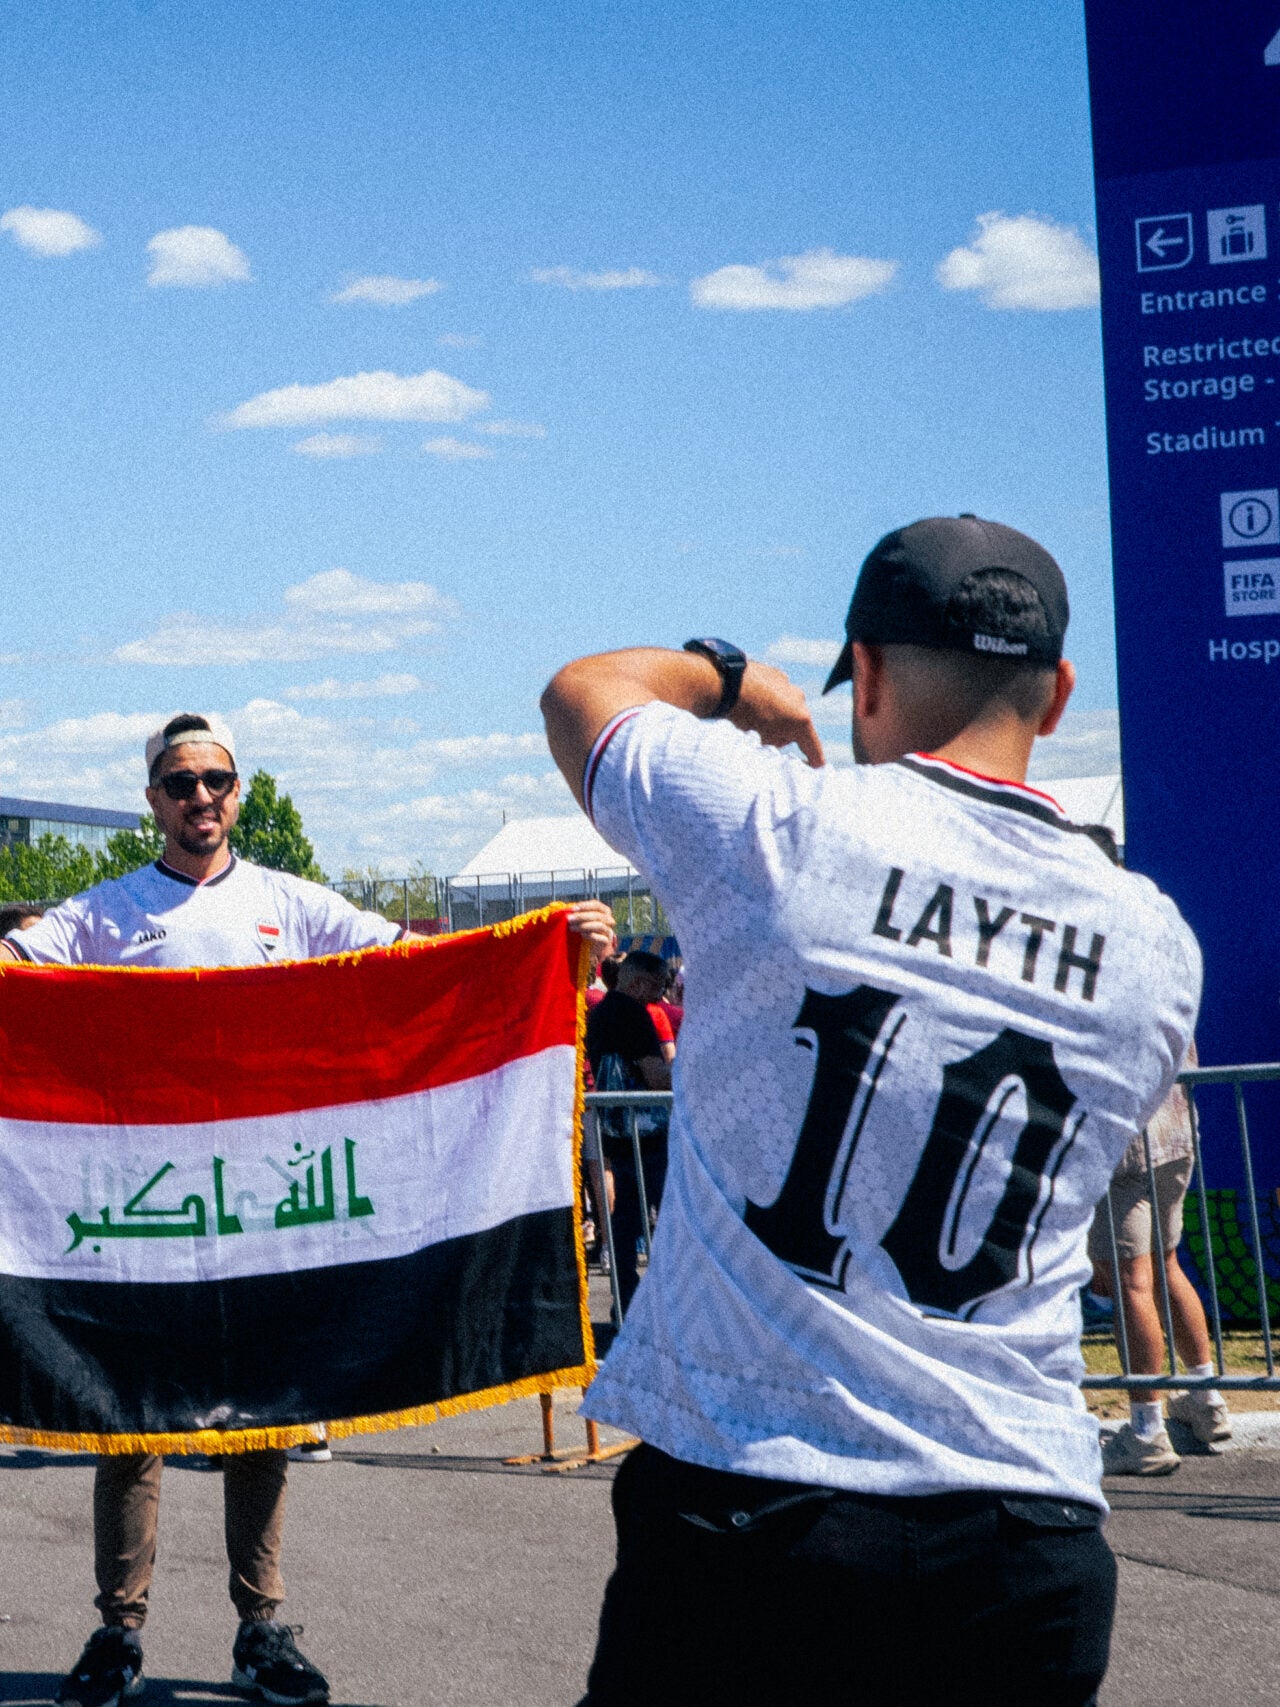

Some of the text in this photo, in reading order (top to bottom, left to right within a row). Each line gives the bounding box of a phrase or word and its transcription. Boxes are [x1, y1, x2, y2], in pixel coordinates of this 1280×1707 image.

[1141, 284, 1266, 315] Entrance
[1144, 374, 1255, 402] Storage
[1147, 425, 1265, 455] Stadium
[1231, 573, 1275, 589] FIFA
[1232, 589, 1276, 602] STORE
[974, 633, 1028, 655] Wilson
[1209, 638, 1280, 665] Hosp
[138, 929, 167, 944] JAKO
[872, 866, 1106, 1002] LAYTH
[744, 984, 1088, 1322] 10
